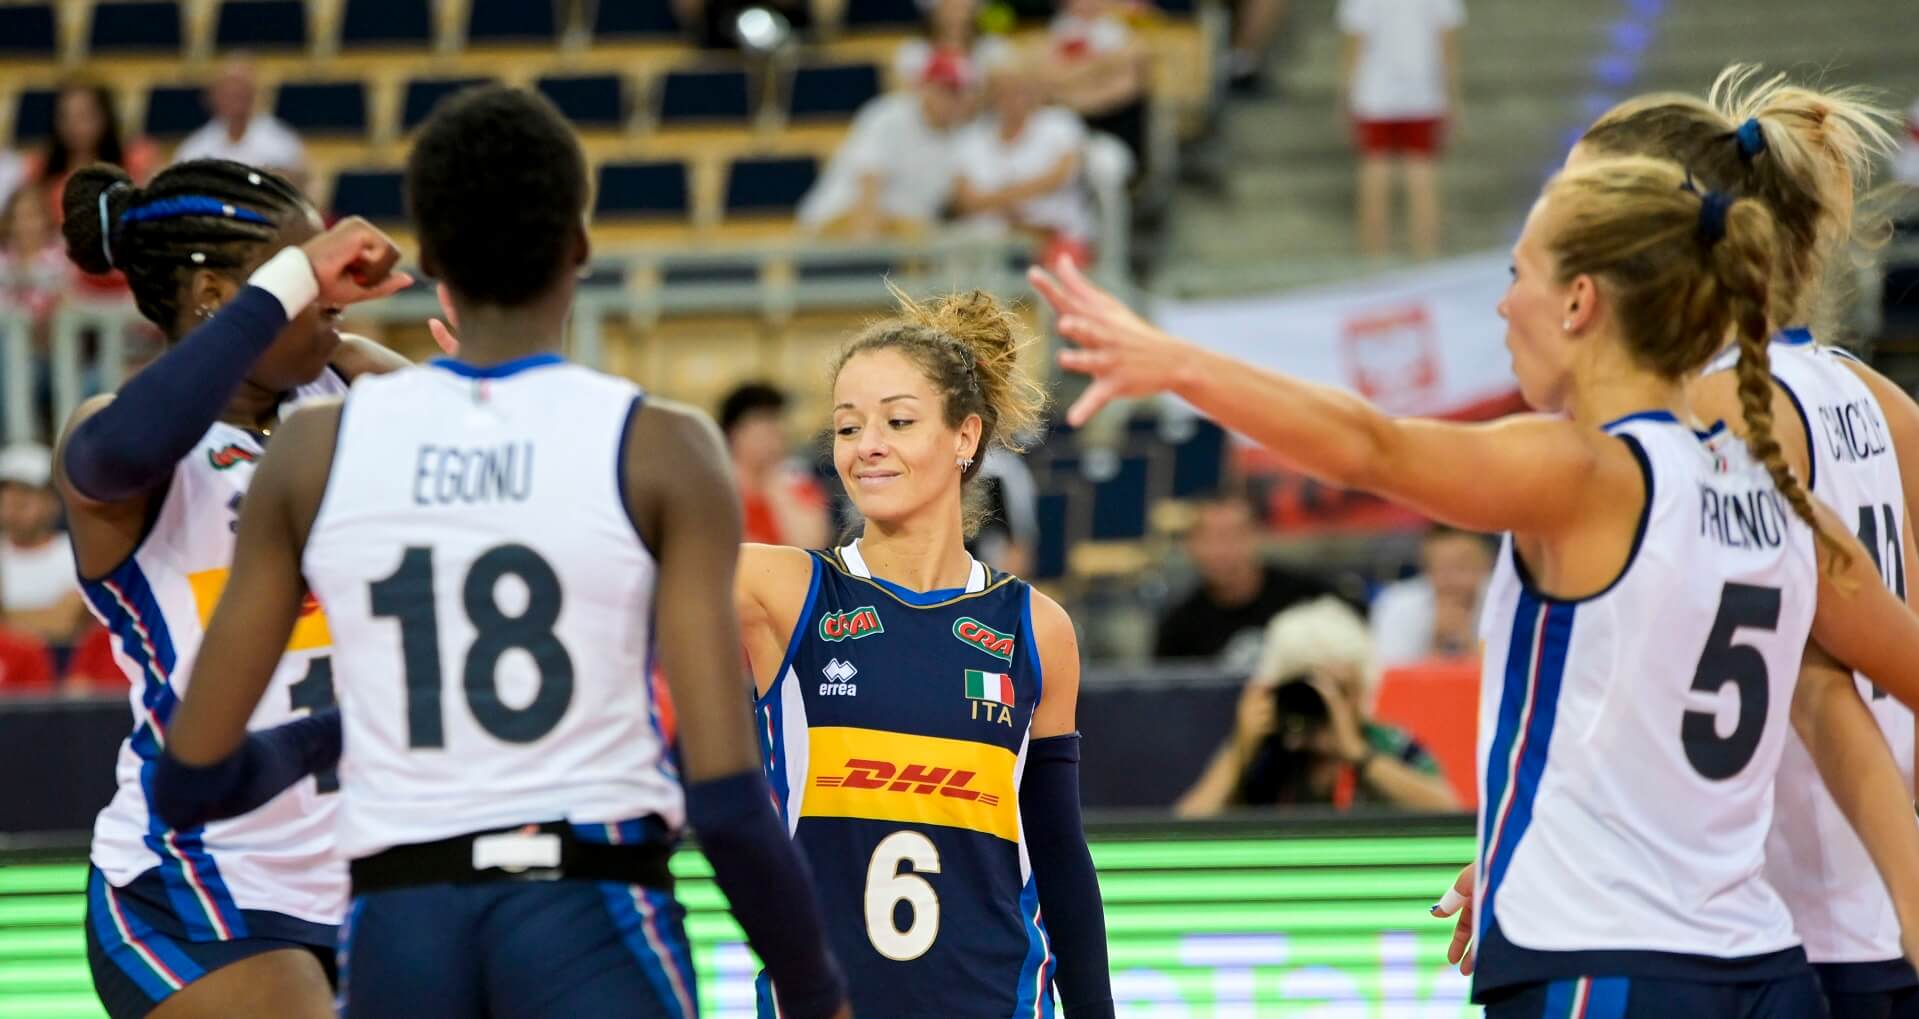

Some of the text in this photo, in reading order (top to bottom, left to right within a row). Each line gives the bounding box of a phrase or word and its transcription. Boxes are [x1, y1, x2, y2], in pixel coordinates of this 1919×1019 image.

[413, 442, 533, 504] EGONU
[368, 543, 575, 750] 18
[957, 620, 1015, 656] CRA
[819, 683, 857, 697] errea
[1681, 582, 1782, 782] 5
[971, 700, 1013, 727] ITA
[841, 758, 981, 801] DHL
[864, 830, 941, 962] 6
